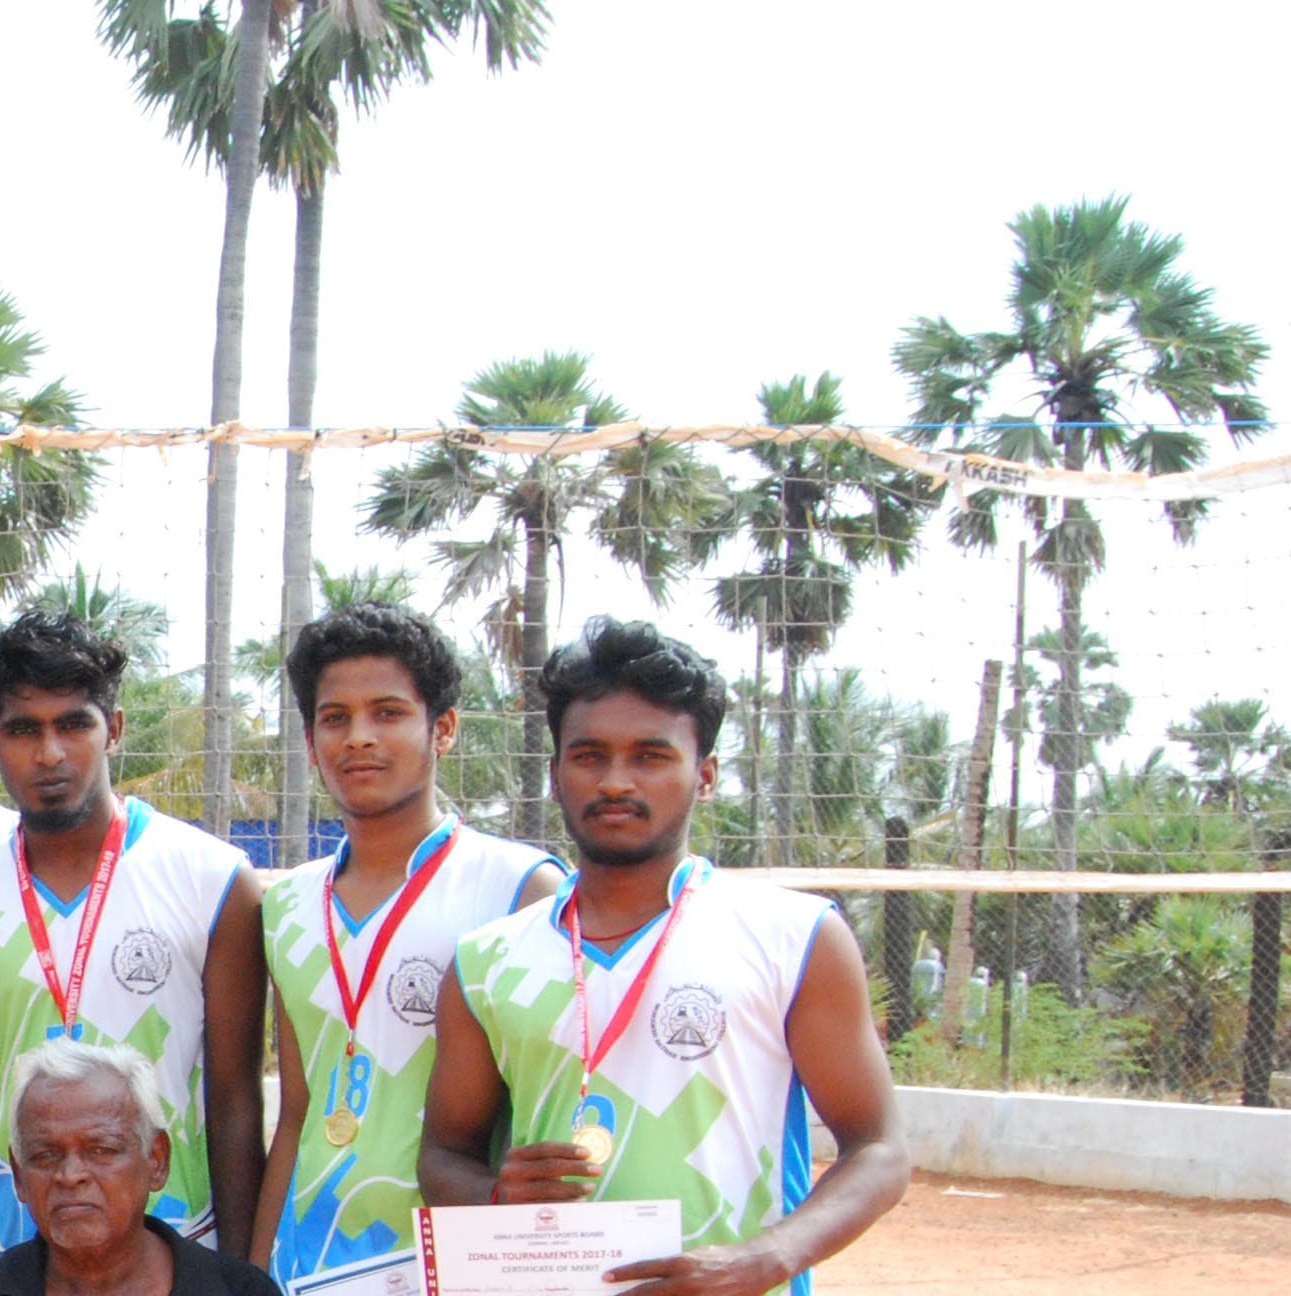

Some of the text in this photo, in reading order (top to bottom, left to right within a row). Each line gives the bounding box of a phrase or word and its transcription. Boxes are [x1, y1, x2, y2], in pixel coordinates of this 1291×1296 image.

[422, 1217, 434, 1256] ANNA
[467, 1249, 623, 1262] ZONAL TOURNAMENTS 2017-18
[502, 1264, 600, 1274] CERTIFICATE OF MERIT
